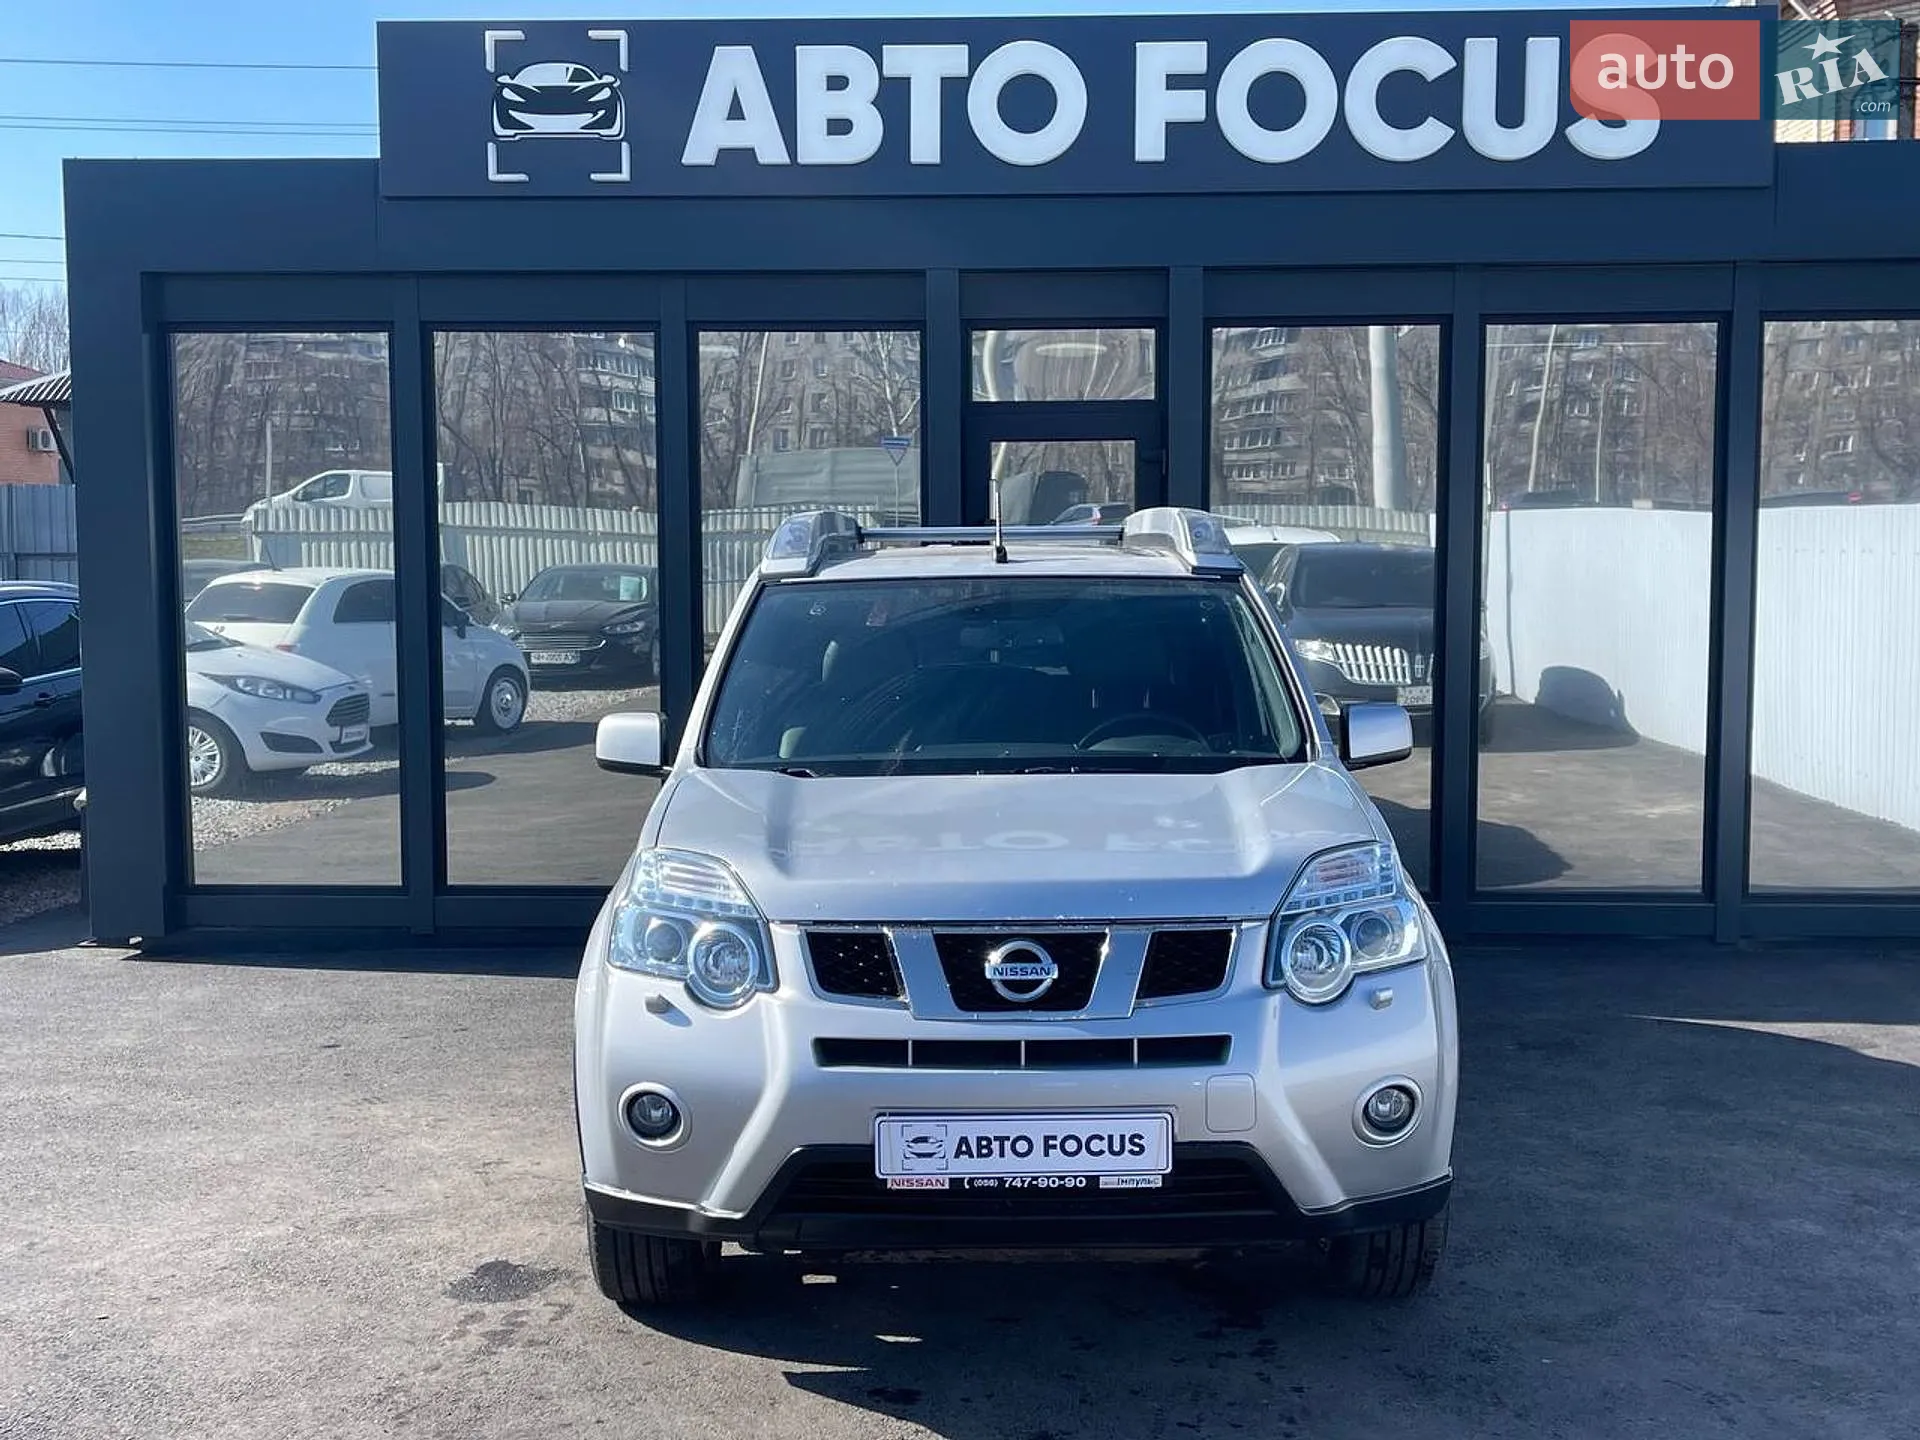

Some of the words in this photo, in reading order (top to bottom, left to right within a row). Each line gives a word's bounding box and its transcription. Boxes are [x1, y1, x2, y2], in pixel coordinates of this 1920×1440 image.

[680, 40, 1088, 167] АВТО
[1133, 33, 1662, 163] FOCUS
[992, 966, 1051, 977] NISSAN
[953, 1135, 1034, 1159] АВТО
[1043, 1133, 1146, 1157] FOCUS
[890, 1177, 946, 1188] NISSAN
[1003, 1176, 1087, 1188] 747-90-90
